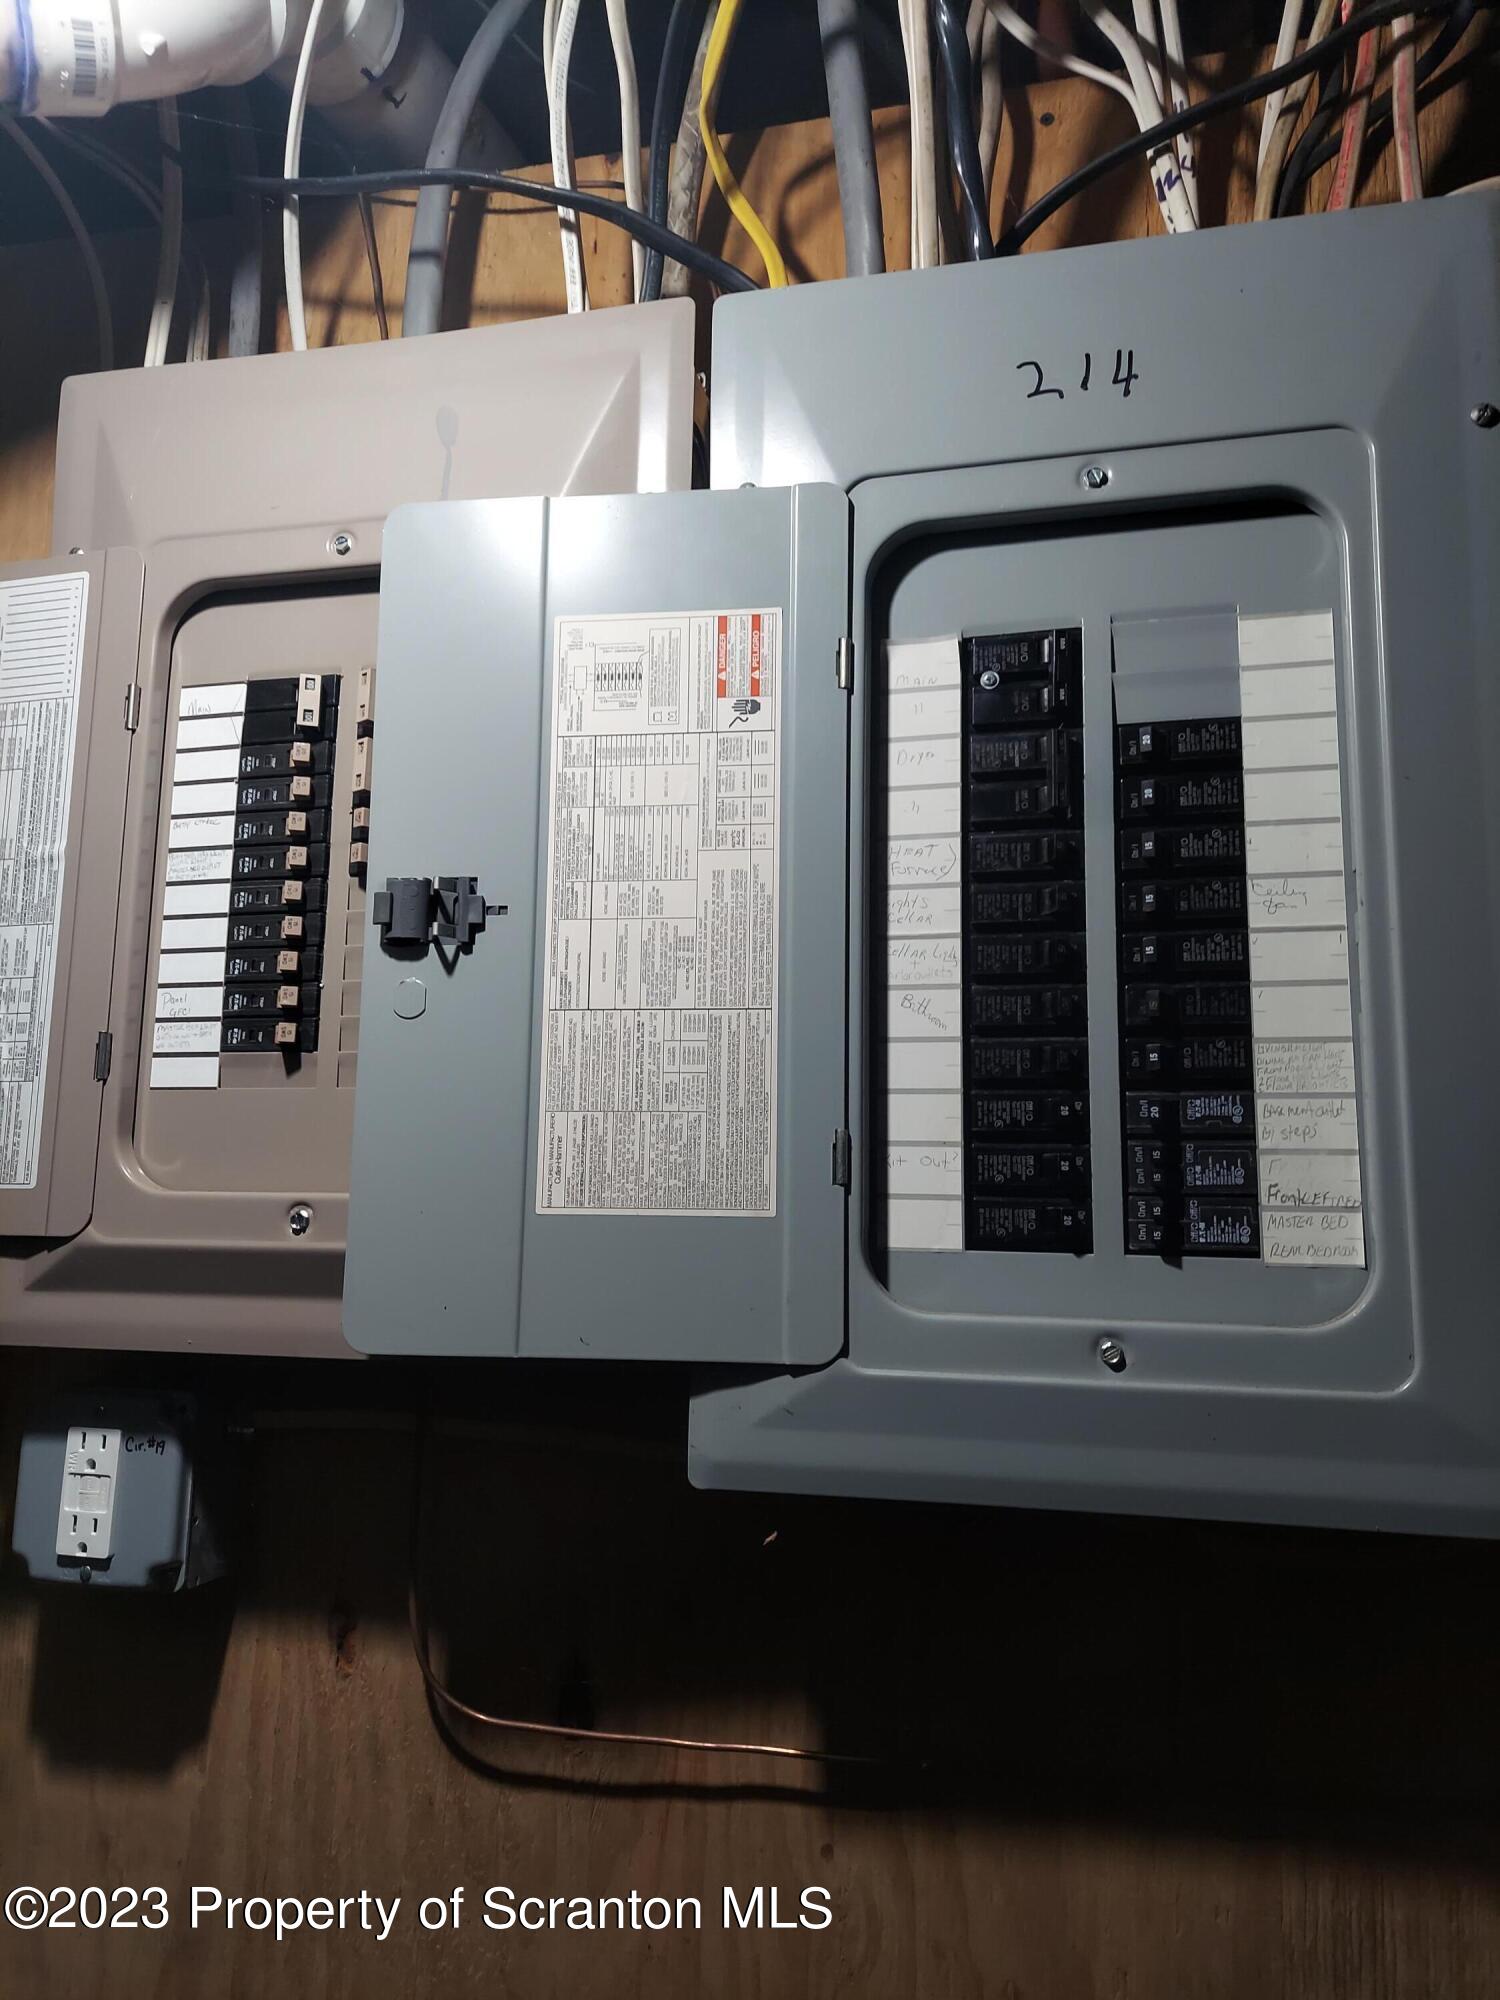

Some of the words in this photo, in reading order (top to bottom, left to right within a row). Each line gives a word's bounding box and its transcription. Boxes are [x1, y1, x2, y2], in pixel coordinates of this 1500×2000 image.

[1015, 347, 1139, 398] 214
[1142, 735, 1151, 745] 20
[1145, 788, 1152, 798] 20
[1145, 842, 1153, 850] 15
[889, 891, 928, 913] ights
[1145, 894, 1154, 903] 15
[1145, 946, 1154, 954] 15
[1149, 1052, 1158, 1061] 15
[1060, 1106, 1069, 1116] 20
[1150, 1107, 1159, 1118] 20
[554, 1135, 562, 1184] Cutler-Hammer
[1153, 1150, 1160, 1159] 15
[1061, 1161, 1069, 1171] 20
[1153, 1207, 1161, 1215] 15
[1063, 1215, 1072, 1226] 20
[1320, 1215, 1348, 1230] BED
[1153, 1231, 1161, 1240] 15
